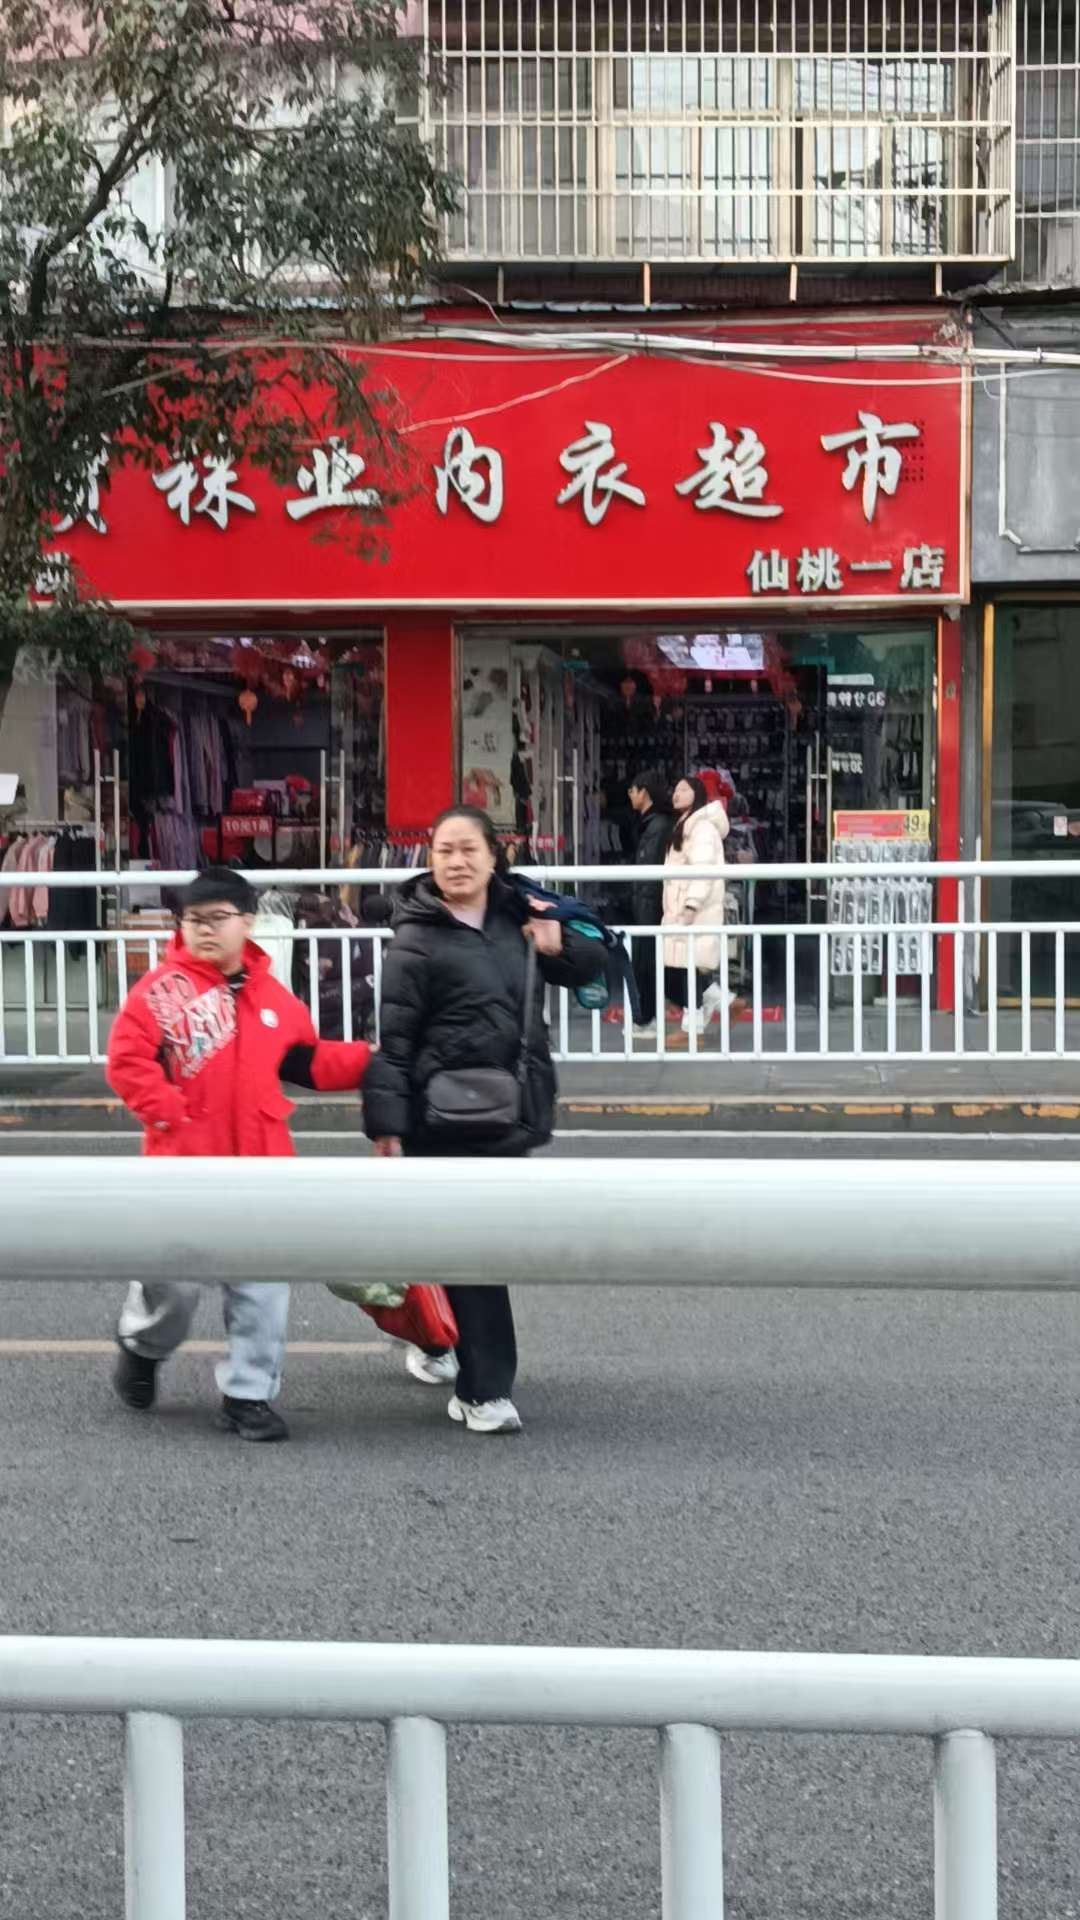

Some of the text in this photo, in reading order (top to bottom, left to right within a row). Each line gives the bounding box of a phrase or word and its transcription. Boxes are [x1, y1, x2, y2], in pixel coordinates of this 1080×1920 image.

[53, 410, 920, 534] 袜业内衣超市
[747, 545, 944, 593] 仙桃一店
